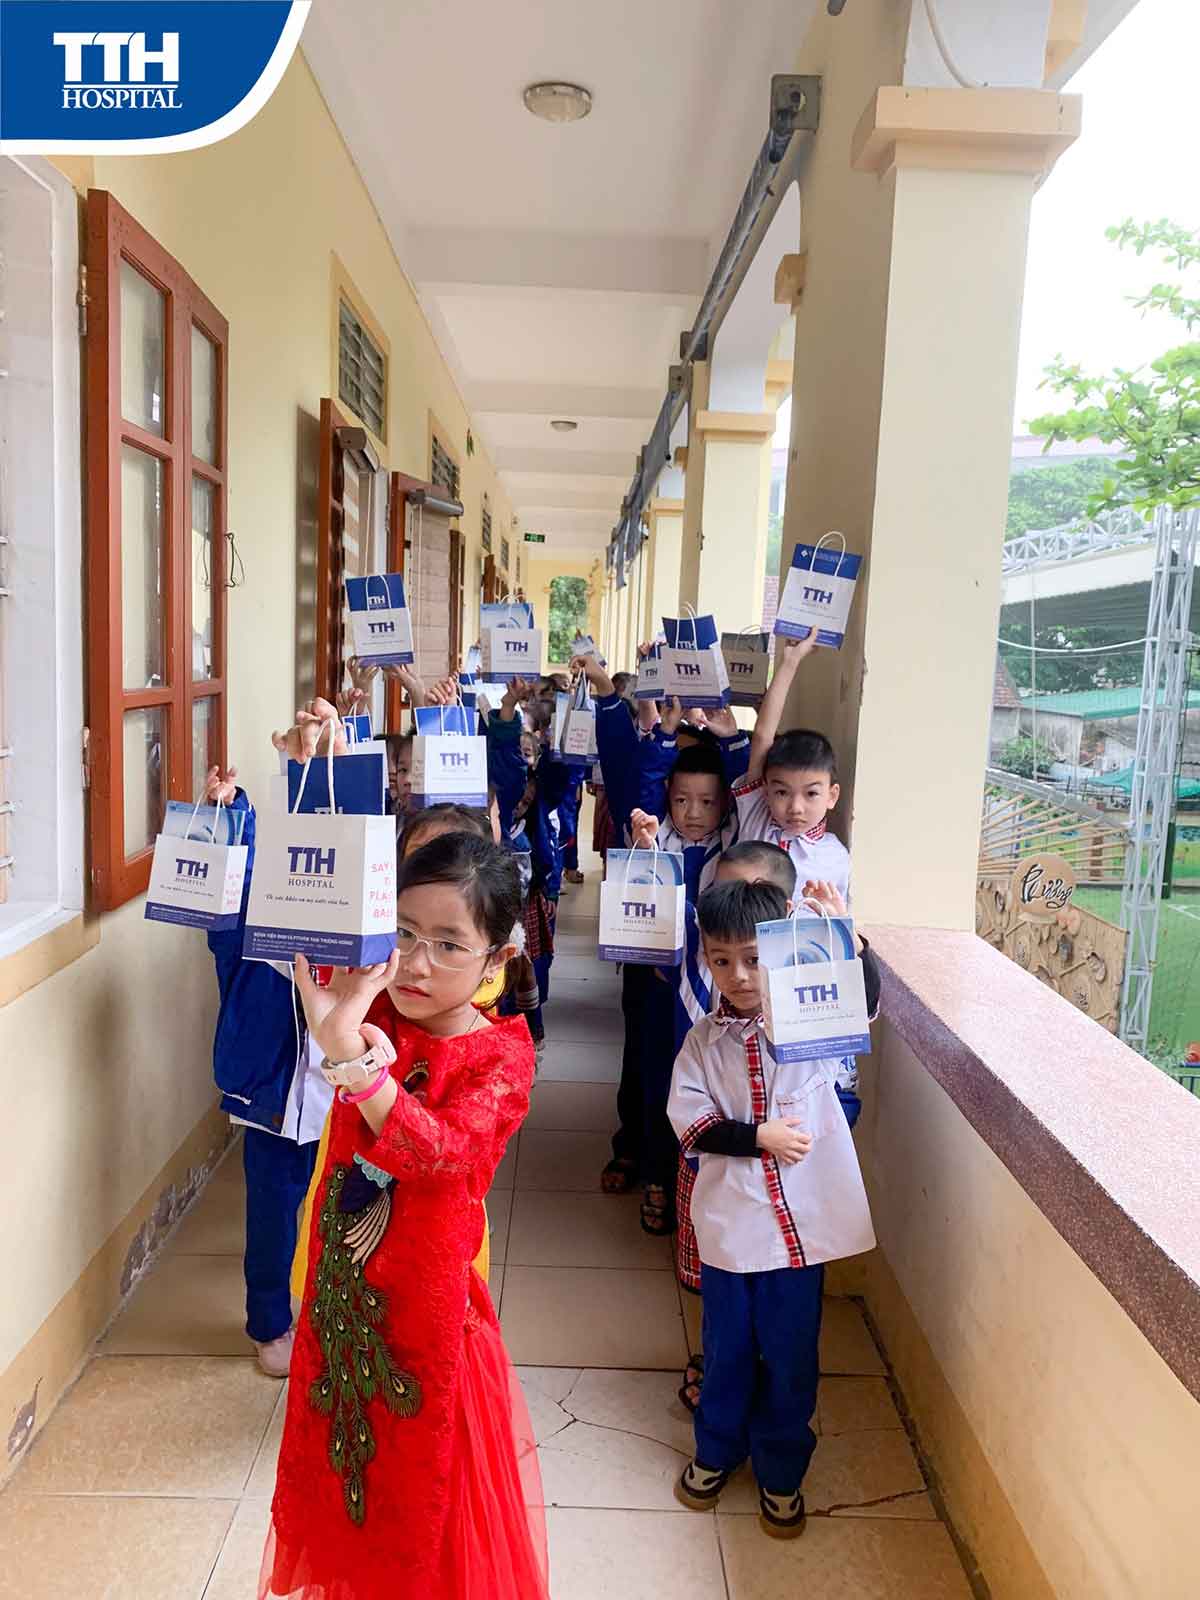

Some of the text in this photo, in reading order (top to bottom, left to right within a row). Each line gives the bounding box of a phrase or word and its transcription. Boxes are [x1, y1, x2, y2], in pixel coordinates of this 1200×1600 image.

[803, 586, 833, 604] TTH
[368, 621, 395, 633] TTH
[504, 640, 529, 652] TTH
[675, 663, 701, 675] TTH
[730, 662, 754, 674] TTH
[440, 753, 469, 766] TTH
[287, 846, 336, 874] TTH
[176, 858, 209, 878] TTH
[288, 877, 335, 889] HOSPITAL
[621, 901, 656, 918] TTH
[794, 983, 839, 1004] TTH
